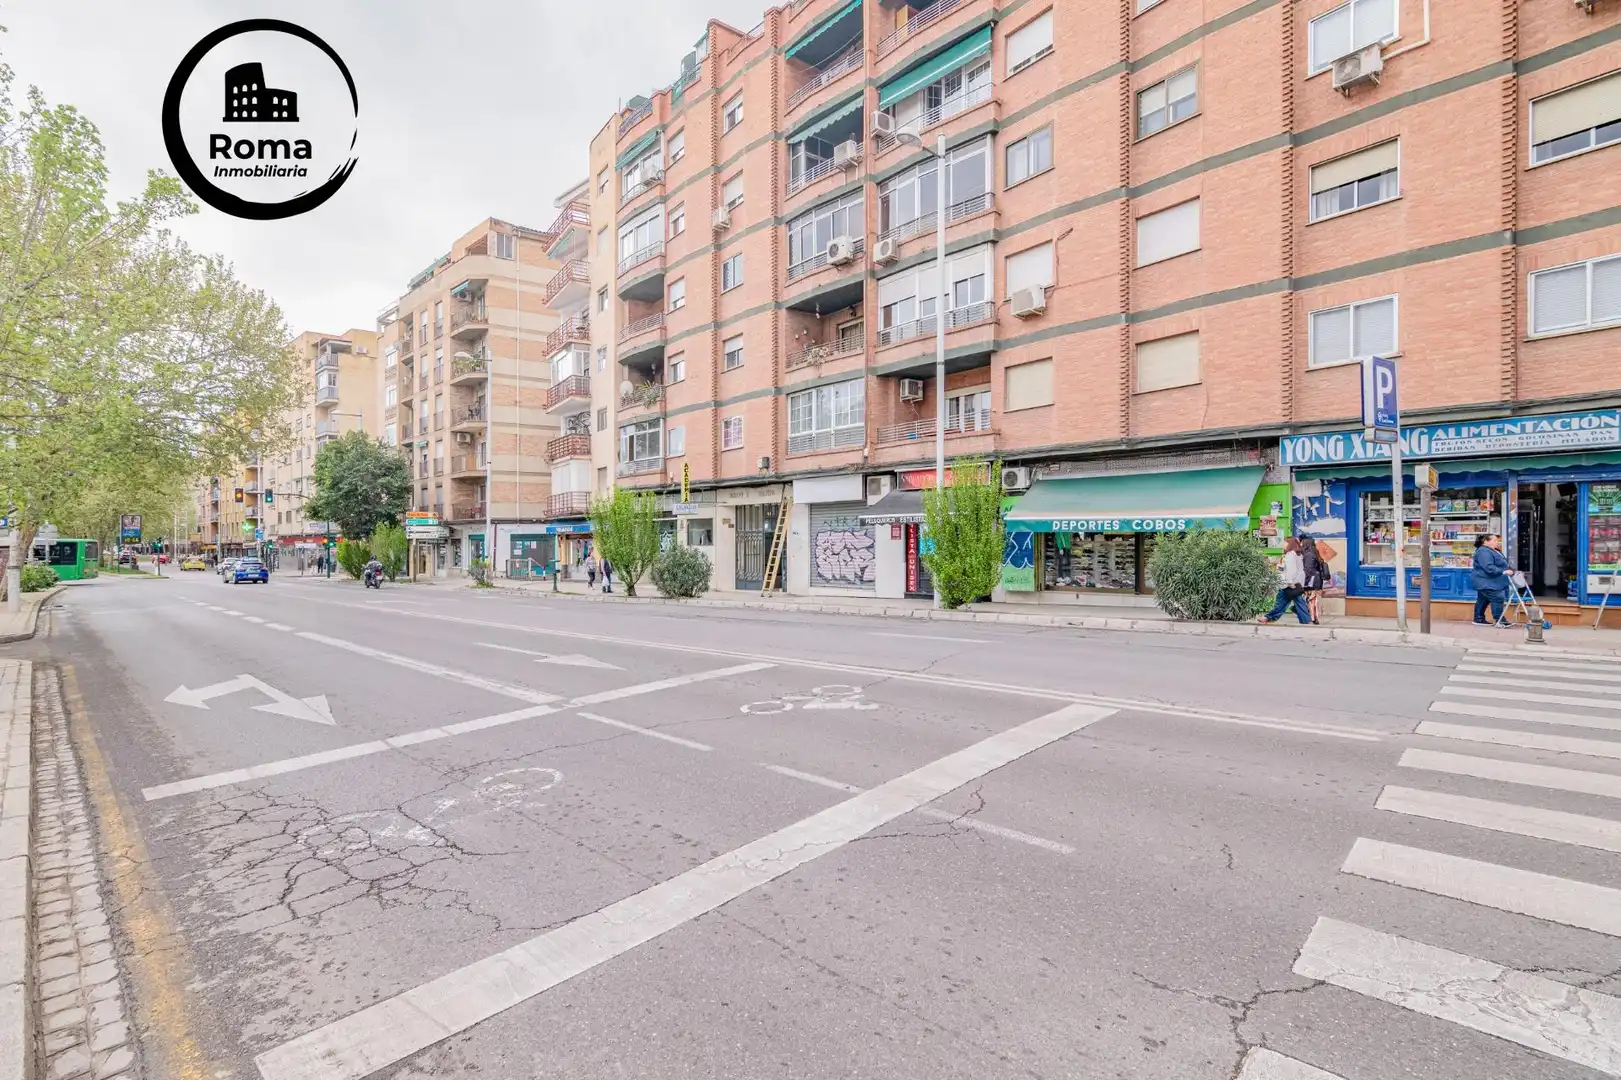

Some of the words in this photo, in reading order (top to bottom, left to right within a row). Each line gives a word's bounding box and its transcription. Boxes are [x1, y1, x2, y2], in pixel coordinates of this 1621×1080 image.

[1376, 365, 1393, 409] P
[1432, 413, 1620, 441] ALIMENTACIÓN
[1283, 435, 1344, 464] YONG
[1052, 520, 1120, 531] DEPORTES
[1131, 519, 1186, 531] COBOS
